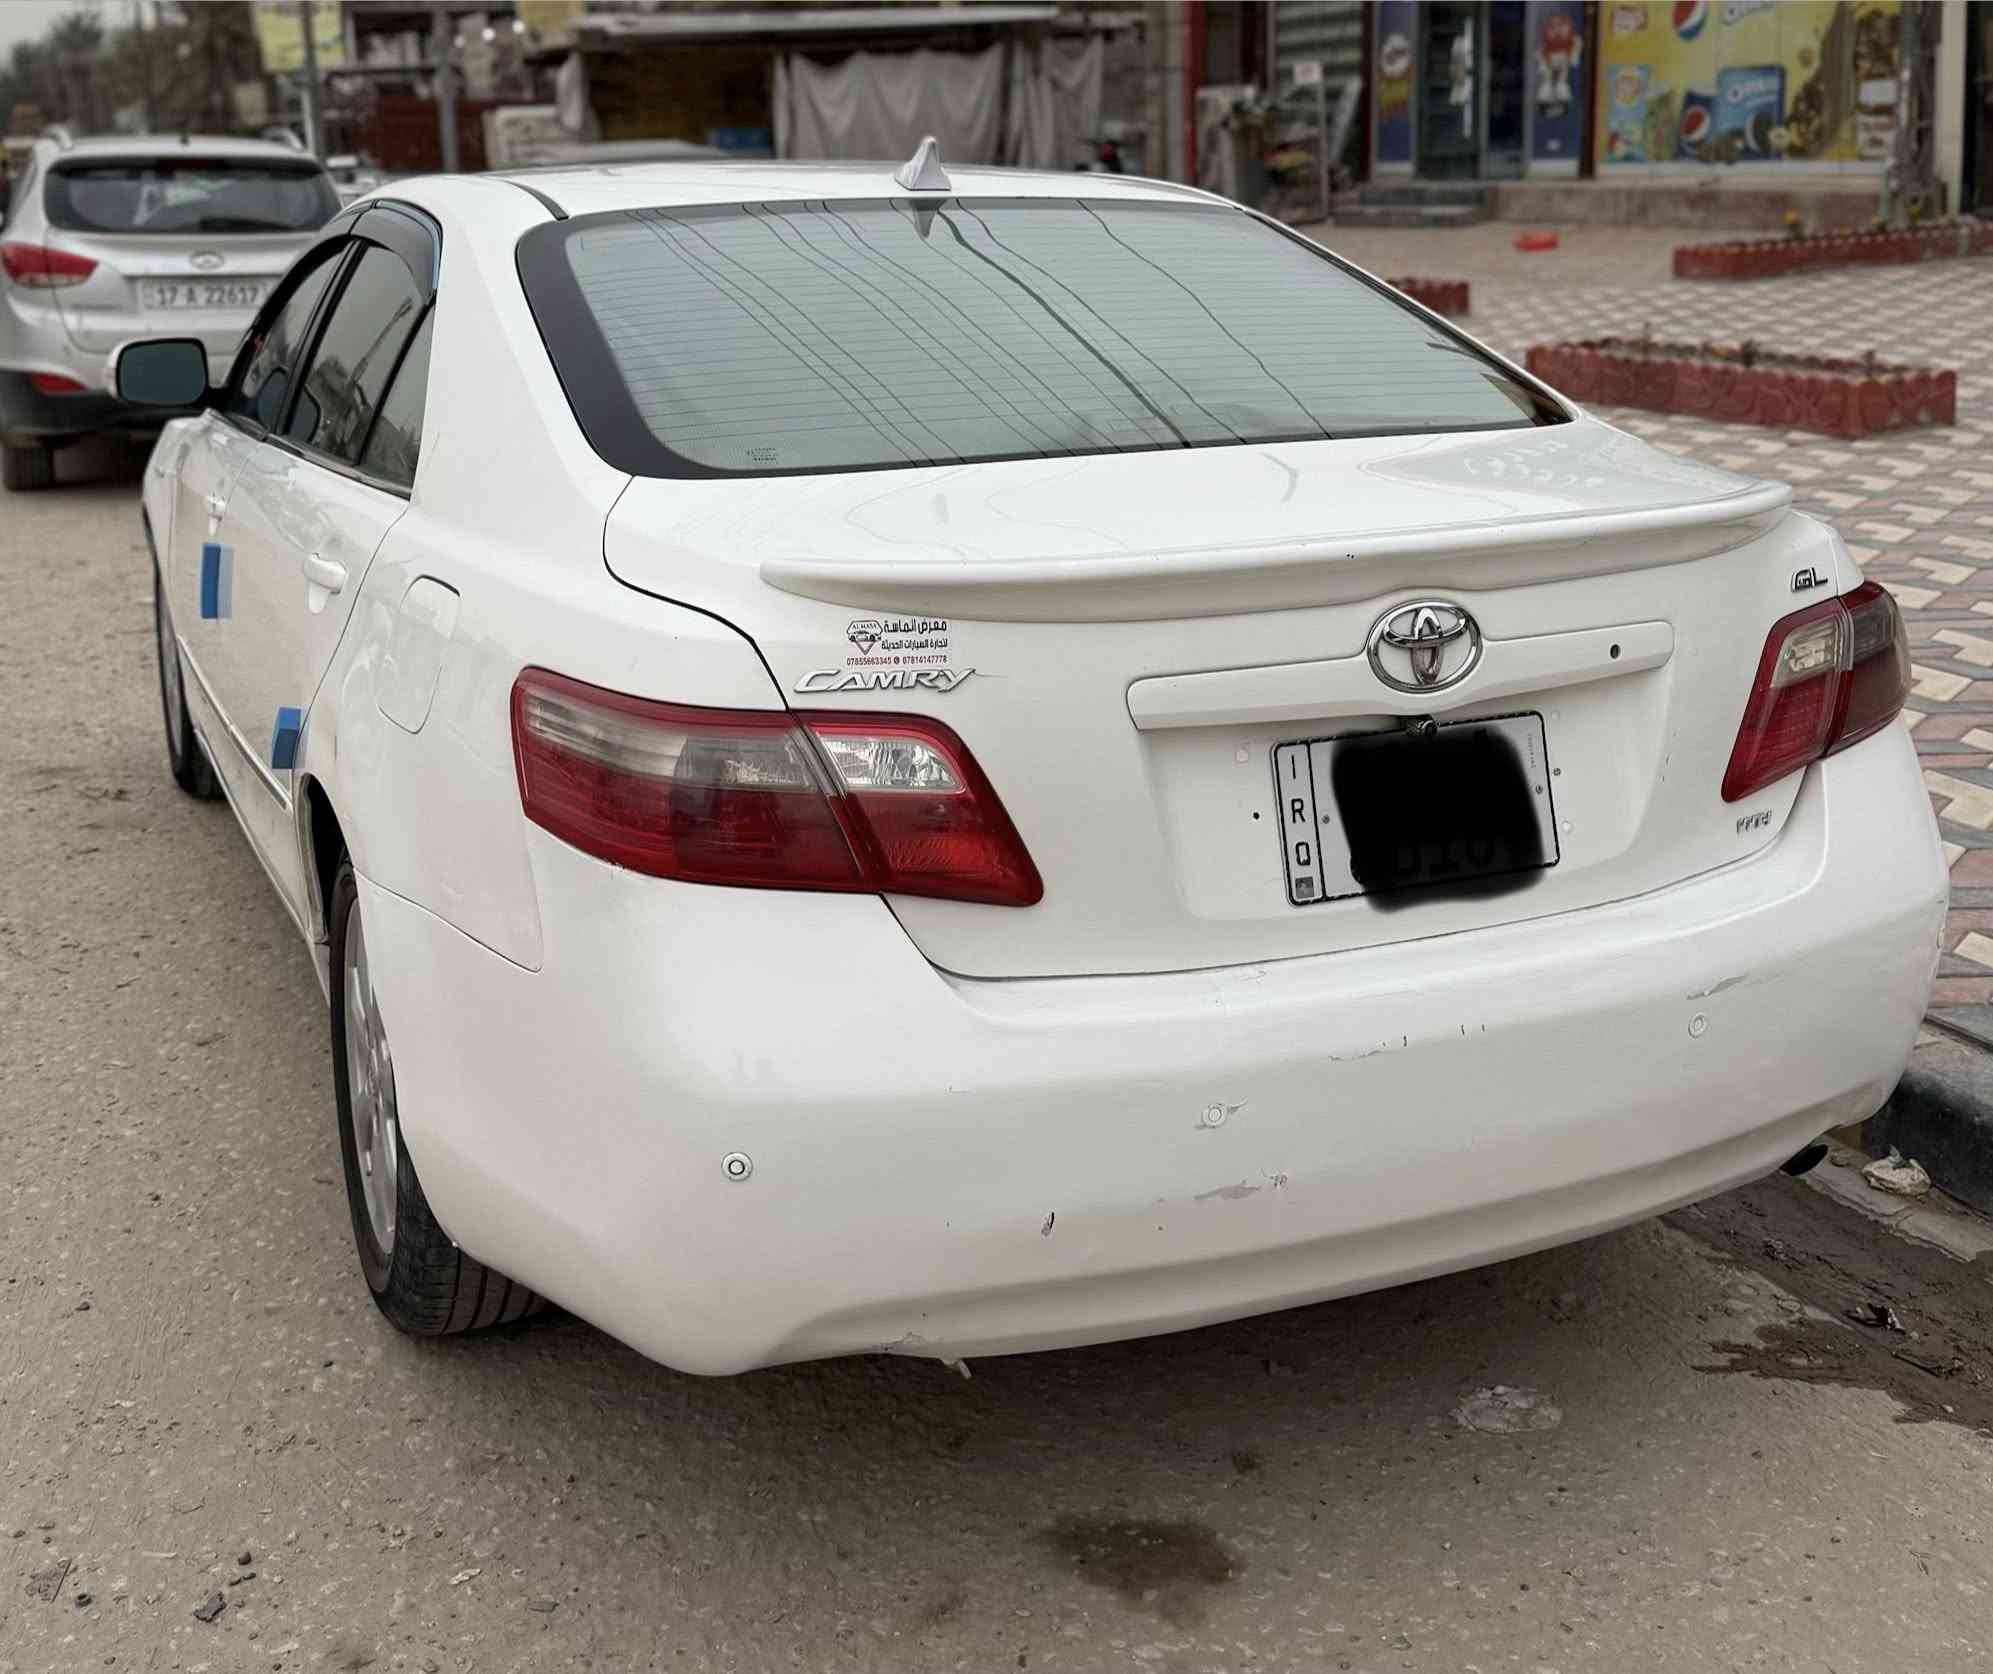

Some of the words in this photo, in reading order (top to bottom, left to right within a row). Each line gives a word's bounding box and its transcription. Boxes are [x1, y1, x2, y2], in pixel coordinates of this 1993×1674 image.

[156, 287, 179, 306] 17
[1791, 567, 1829, 592] GL
[883, 618, 916, 634] الماسة
[917, 619, 947, 635] معرض
[881, 639, 903, 650] الحديثة
[903, 638, 929, 651] السيارات
[793, 667, 977, 694] CAMRY
